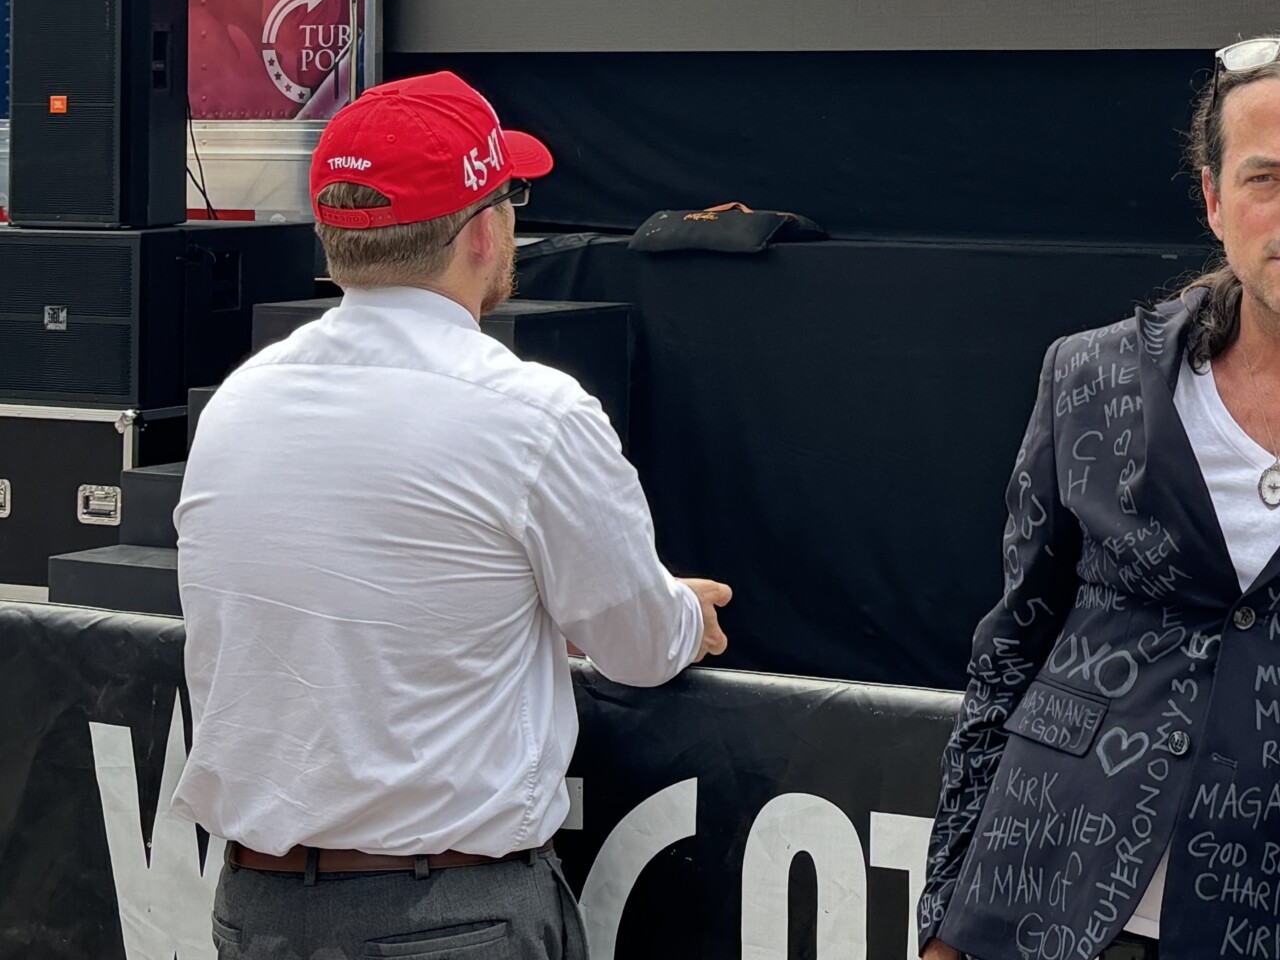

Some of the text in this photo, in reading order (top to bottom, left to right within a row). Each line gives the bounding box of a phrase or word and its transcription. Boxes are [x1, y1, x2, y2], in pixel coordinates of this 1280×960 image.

[327, 156, 372, 172] TRUMP
[463, 127, 504, 191] 45-47
[1188, 831, 1248, 869] GOD
[965, 862, 983, 905] A
[1016, 912, 1076, 960] GOD
